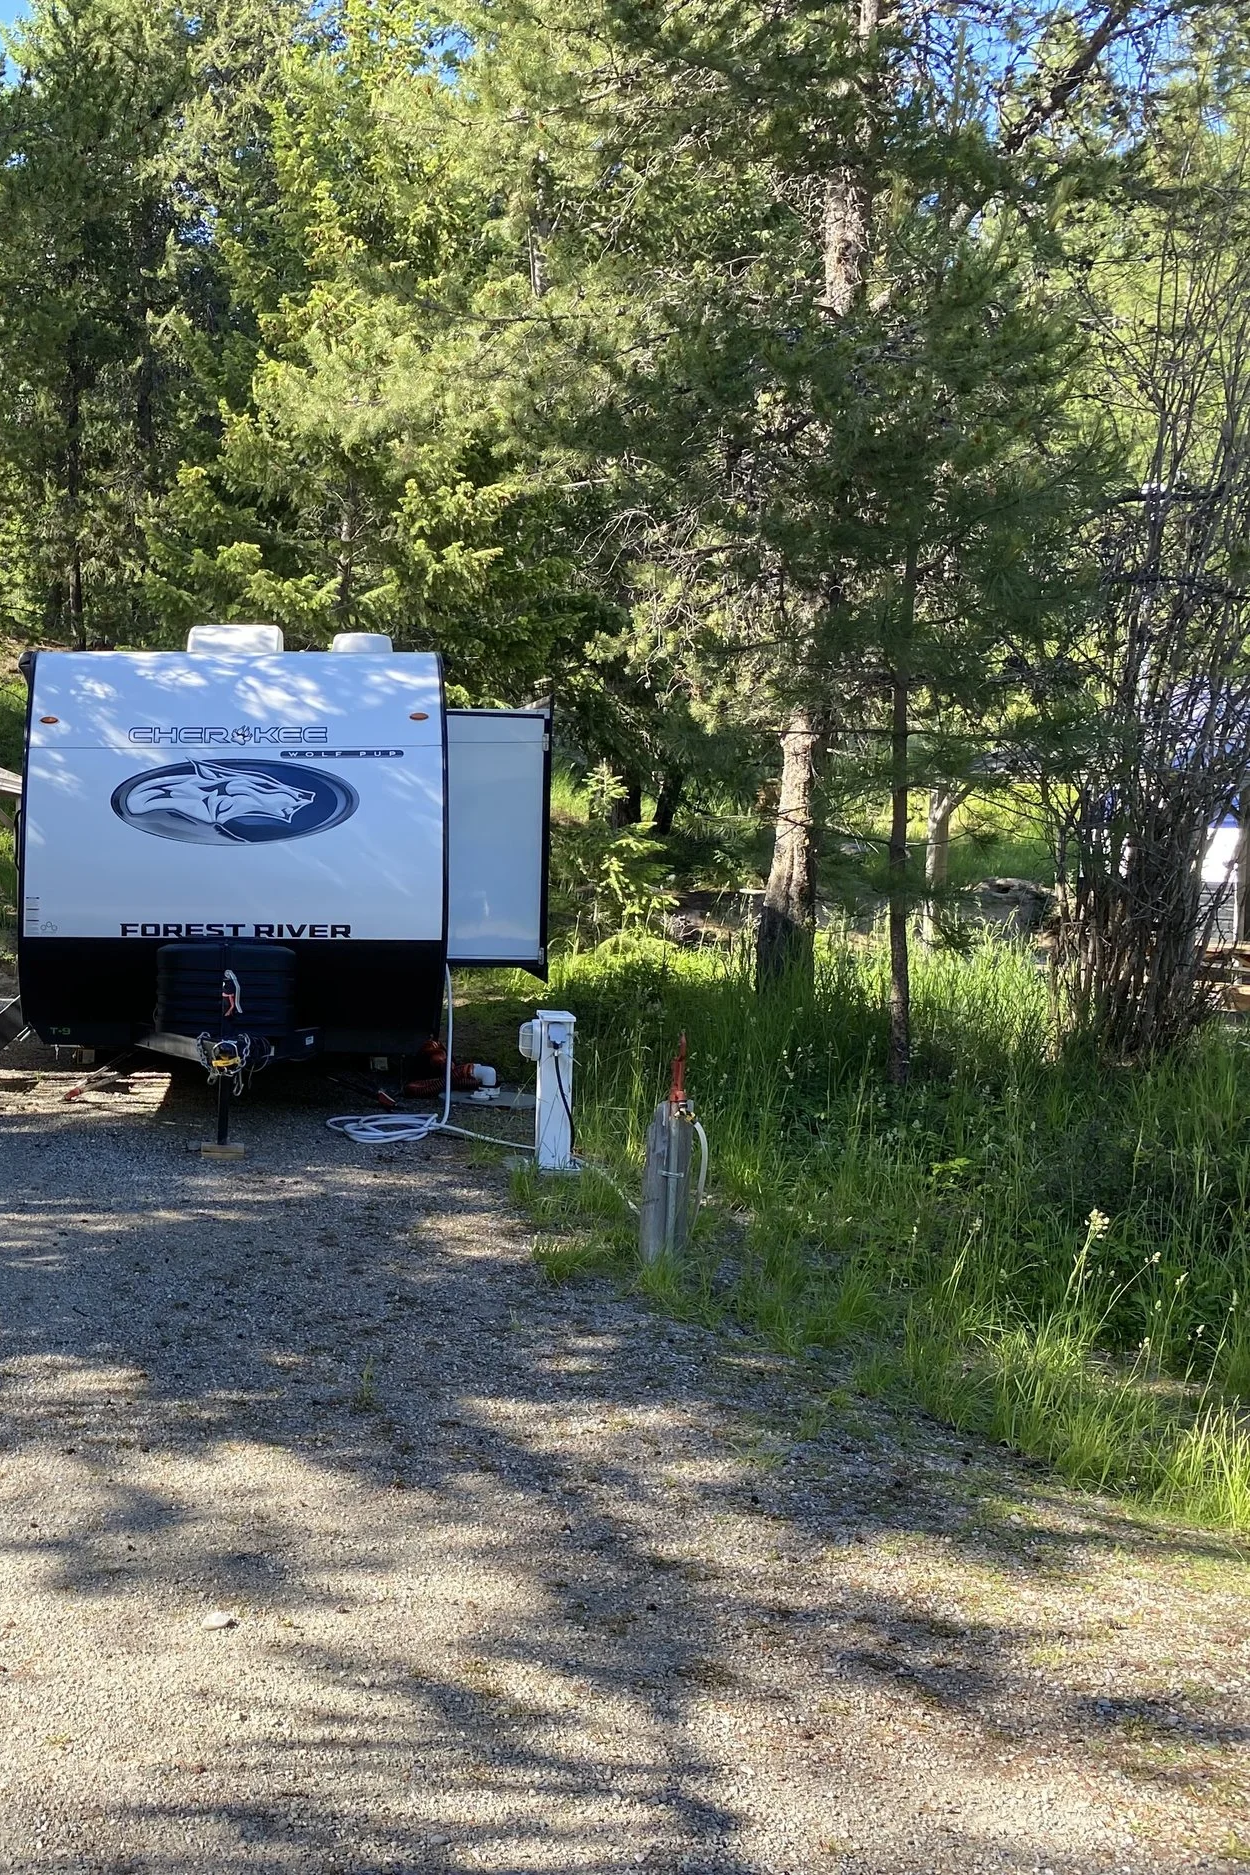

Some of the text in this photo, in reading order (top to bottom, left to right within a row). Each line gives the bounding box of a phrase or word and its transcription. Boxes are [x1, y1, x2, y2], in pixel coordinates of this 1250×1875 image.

[288, 750, 398, 758] WOLF PUP
[120, 923, 352, 938] FOREST RIVER
